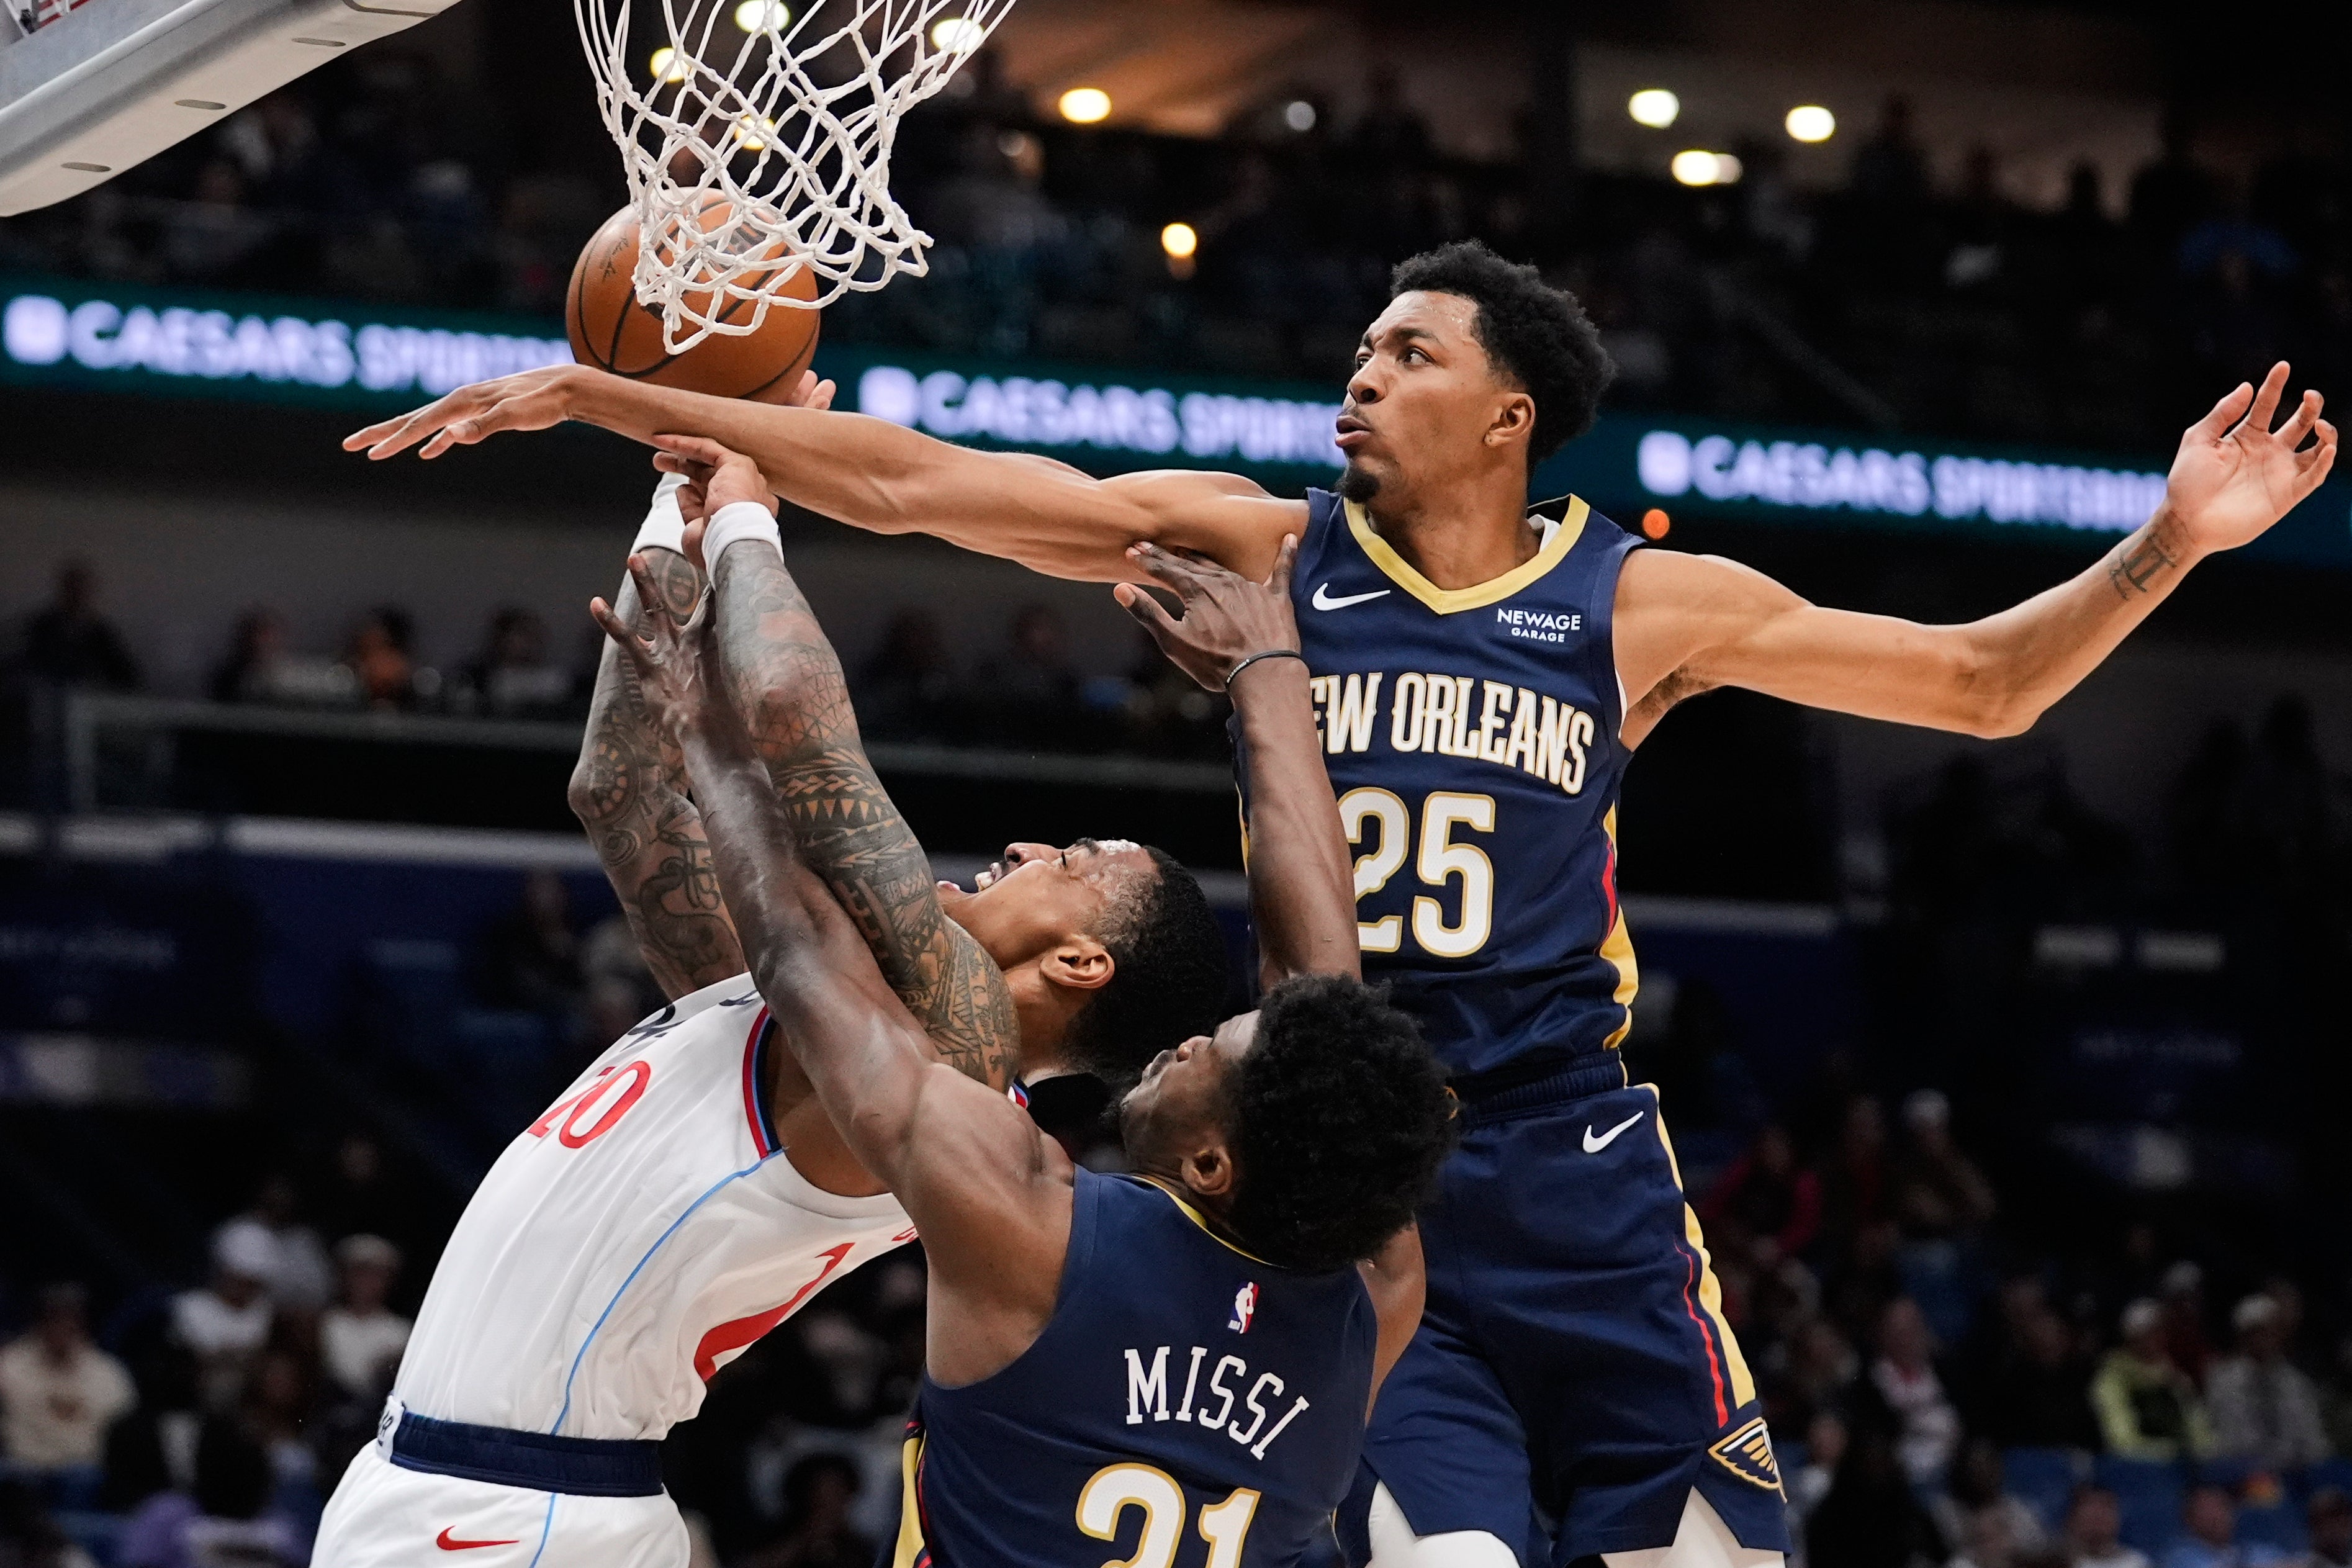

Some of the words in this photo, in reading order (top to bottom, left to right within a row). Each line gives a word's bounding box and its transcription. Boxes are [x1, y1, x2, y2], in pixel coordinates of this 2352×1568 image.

[69, 300, 356, 388] CAESARS
[919, 371, 1181, 453] CAESARS
[1690, 435, 1931, 516] CAESARS
[1497, 608, 1581, 631] NEWAGE
[1511, 627, 1566, 643] GARAGE
[1310, 672, 1383, 754] EW
[1391, 672, 1595, 795] ORLEANS
[1336, 786, 1496, 957] 25
[1124, 1346, 1310, 1461] MISSI
